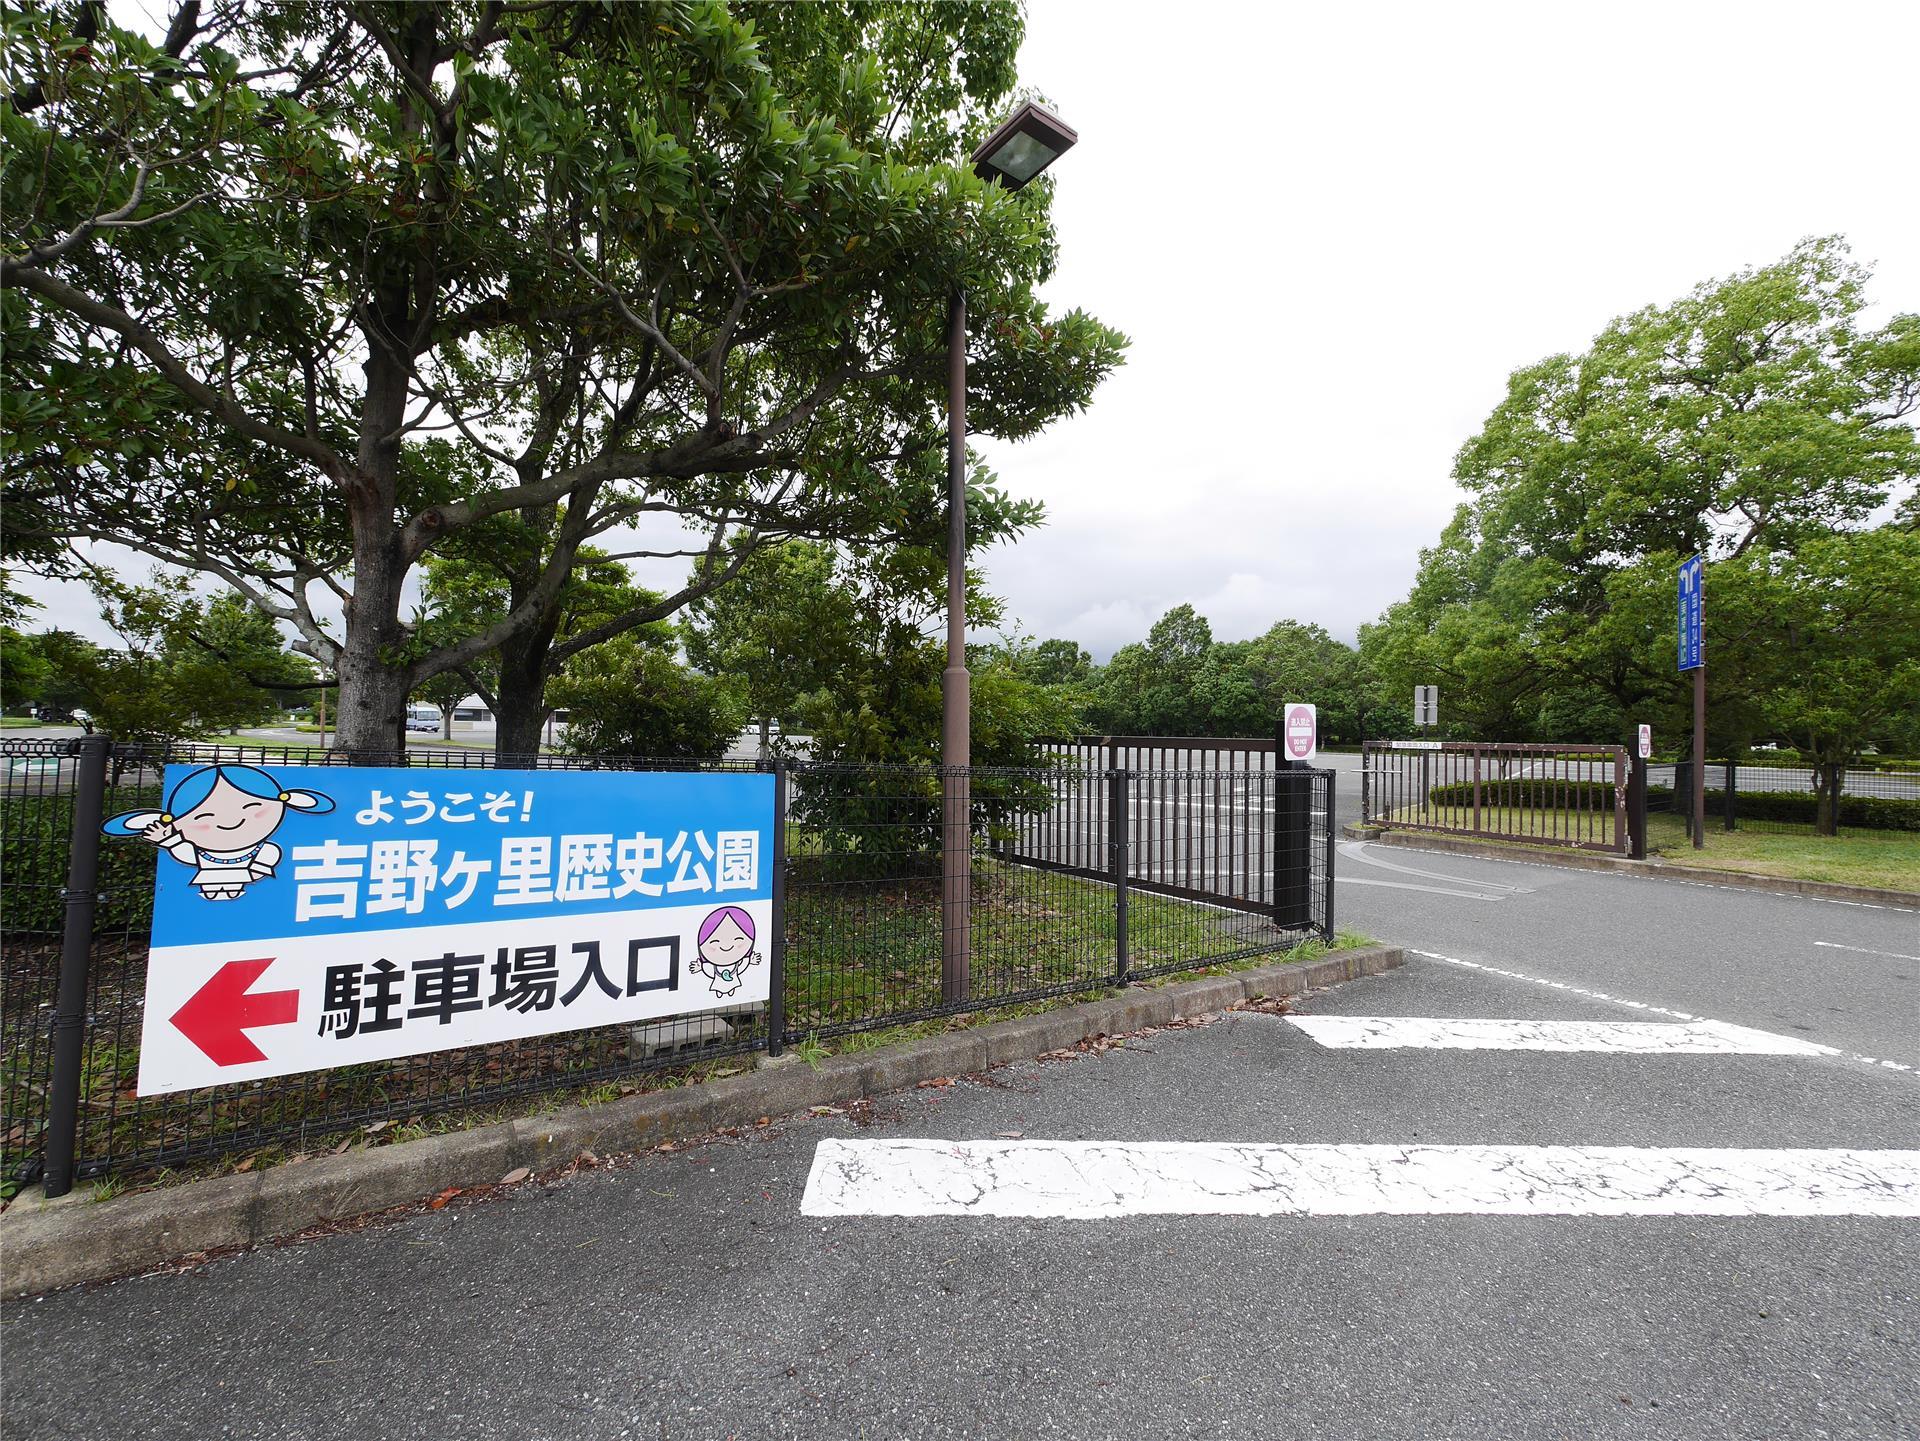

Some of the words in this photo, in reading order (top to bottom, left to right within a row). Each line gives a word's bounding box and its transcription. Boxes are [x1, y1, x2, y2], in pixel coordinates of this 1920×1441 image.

[292, 830, 760, 923] 吉野ヶ里歴史公園
[317, 935, 682, 1040] 駐車場入口
